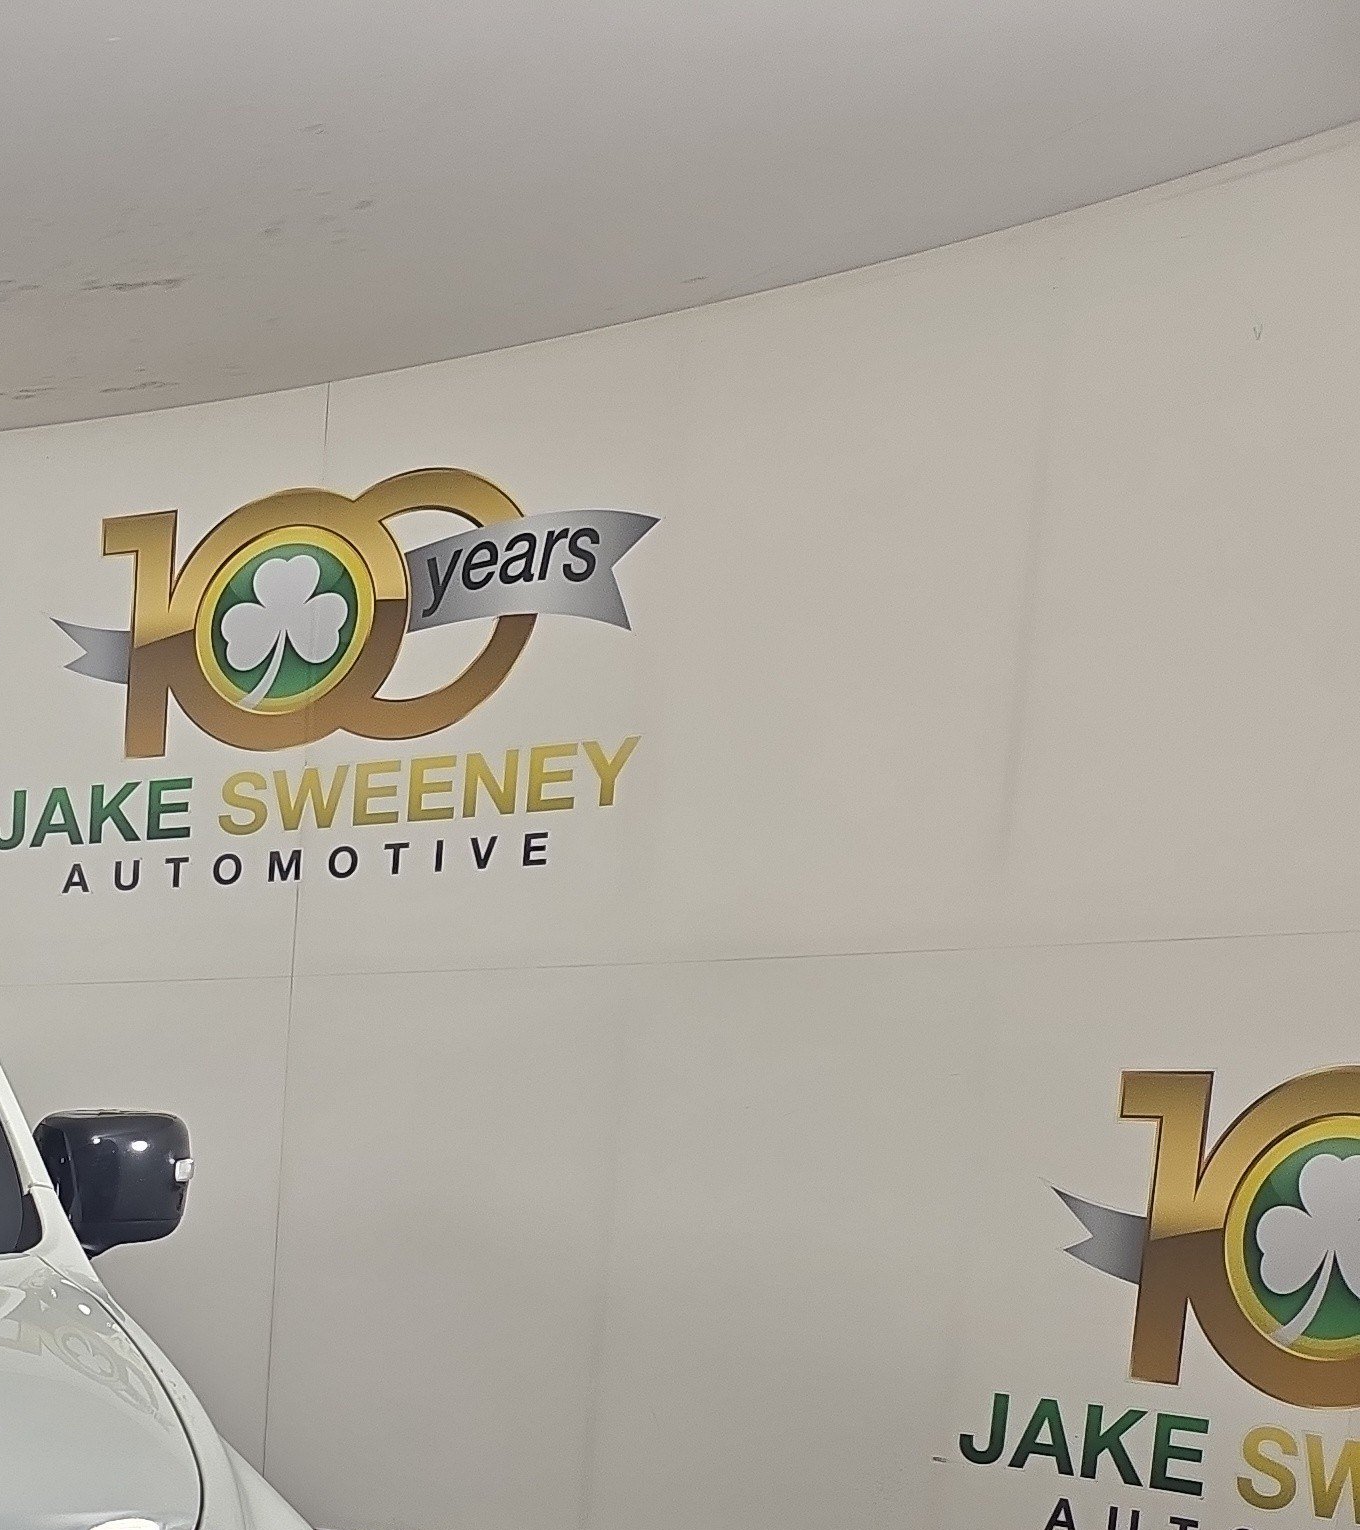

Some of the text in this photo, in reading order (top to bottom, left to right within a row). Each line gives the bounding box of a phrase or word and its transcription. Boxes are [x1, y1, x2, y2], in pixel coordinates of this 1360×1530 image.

[103, 467, 601, 759] 100 years
[218, 736, 641, 836] SWEENEY
[62, 832, 550, 894] AUTOMOTIVE
[959, 1393, 1360, 1525] JAKE SW
